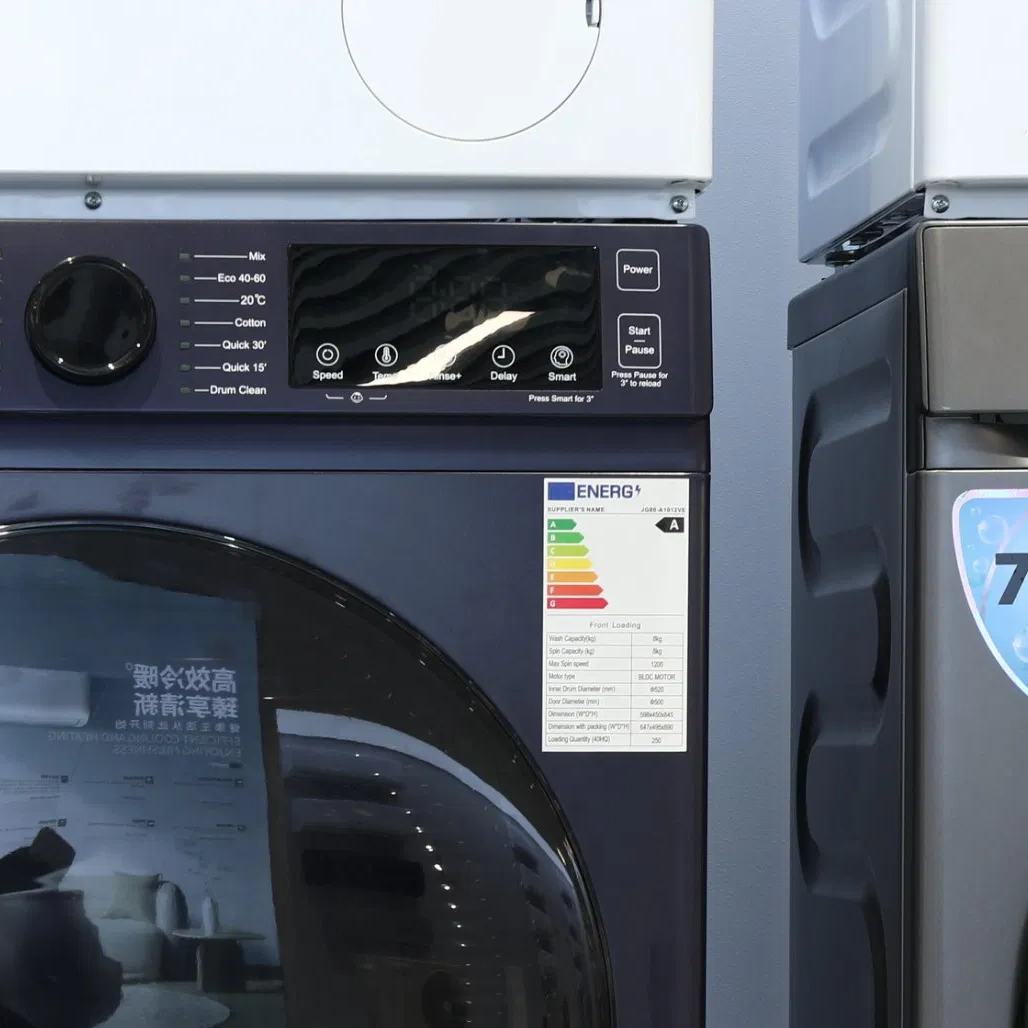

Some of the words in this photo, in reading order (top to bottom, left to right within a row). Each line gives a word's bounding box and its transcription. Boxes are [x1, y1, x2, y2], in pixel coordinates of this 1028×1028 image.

[249, 252, 266, 261] Mix
[623, 264, 653, 275] Power
[218, 274, 236, 284] Eco
[238, 274, 266, 284] 40-60
[235, 318, 266, 328] Cotton
[628, 325, 651, 336] Start
[222, 340, 250, 351] Quick
[625, 345, 655, 355] Pause
[222, 363, 250, 374] Quick
[312, 370, 344, 382] Speed
[490, 371, 518, 383] Delay
[548, 372, 577, 382] Smart
[611, 371, 632, 379] Press
[634, 371, 657, 379] Pause
[659, 371, 669, 379] for
[630, 379, 638, 387] to
[210, 385, 237, 395] Drum
[238, 385, 266, 395] Clean
[528, 394, 550, 402] Press
[552, 395, 573, 403] Smart
[575, 395, 585, 403] for
[577, 484, 633, 499] ENERG
[669, 519, 680, 531] A
[995, 552, 1028, 605] 7
[612, 622, 641, 630] Loading
[561, 660, 572, 668] Spin
[573, 660, 589, 668] speed
[564, 673, 575, 681] type
